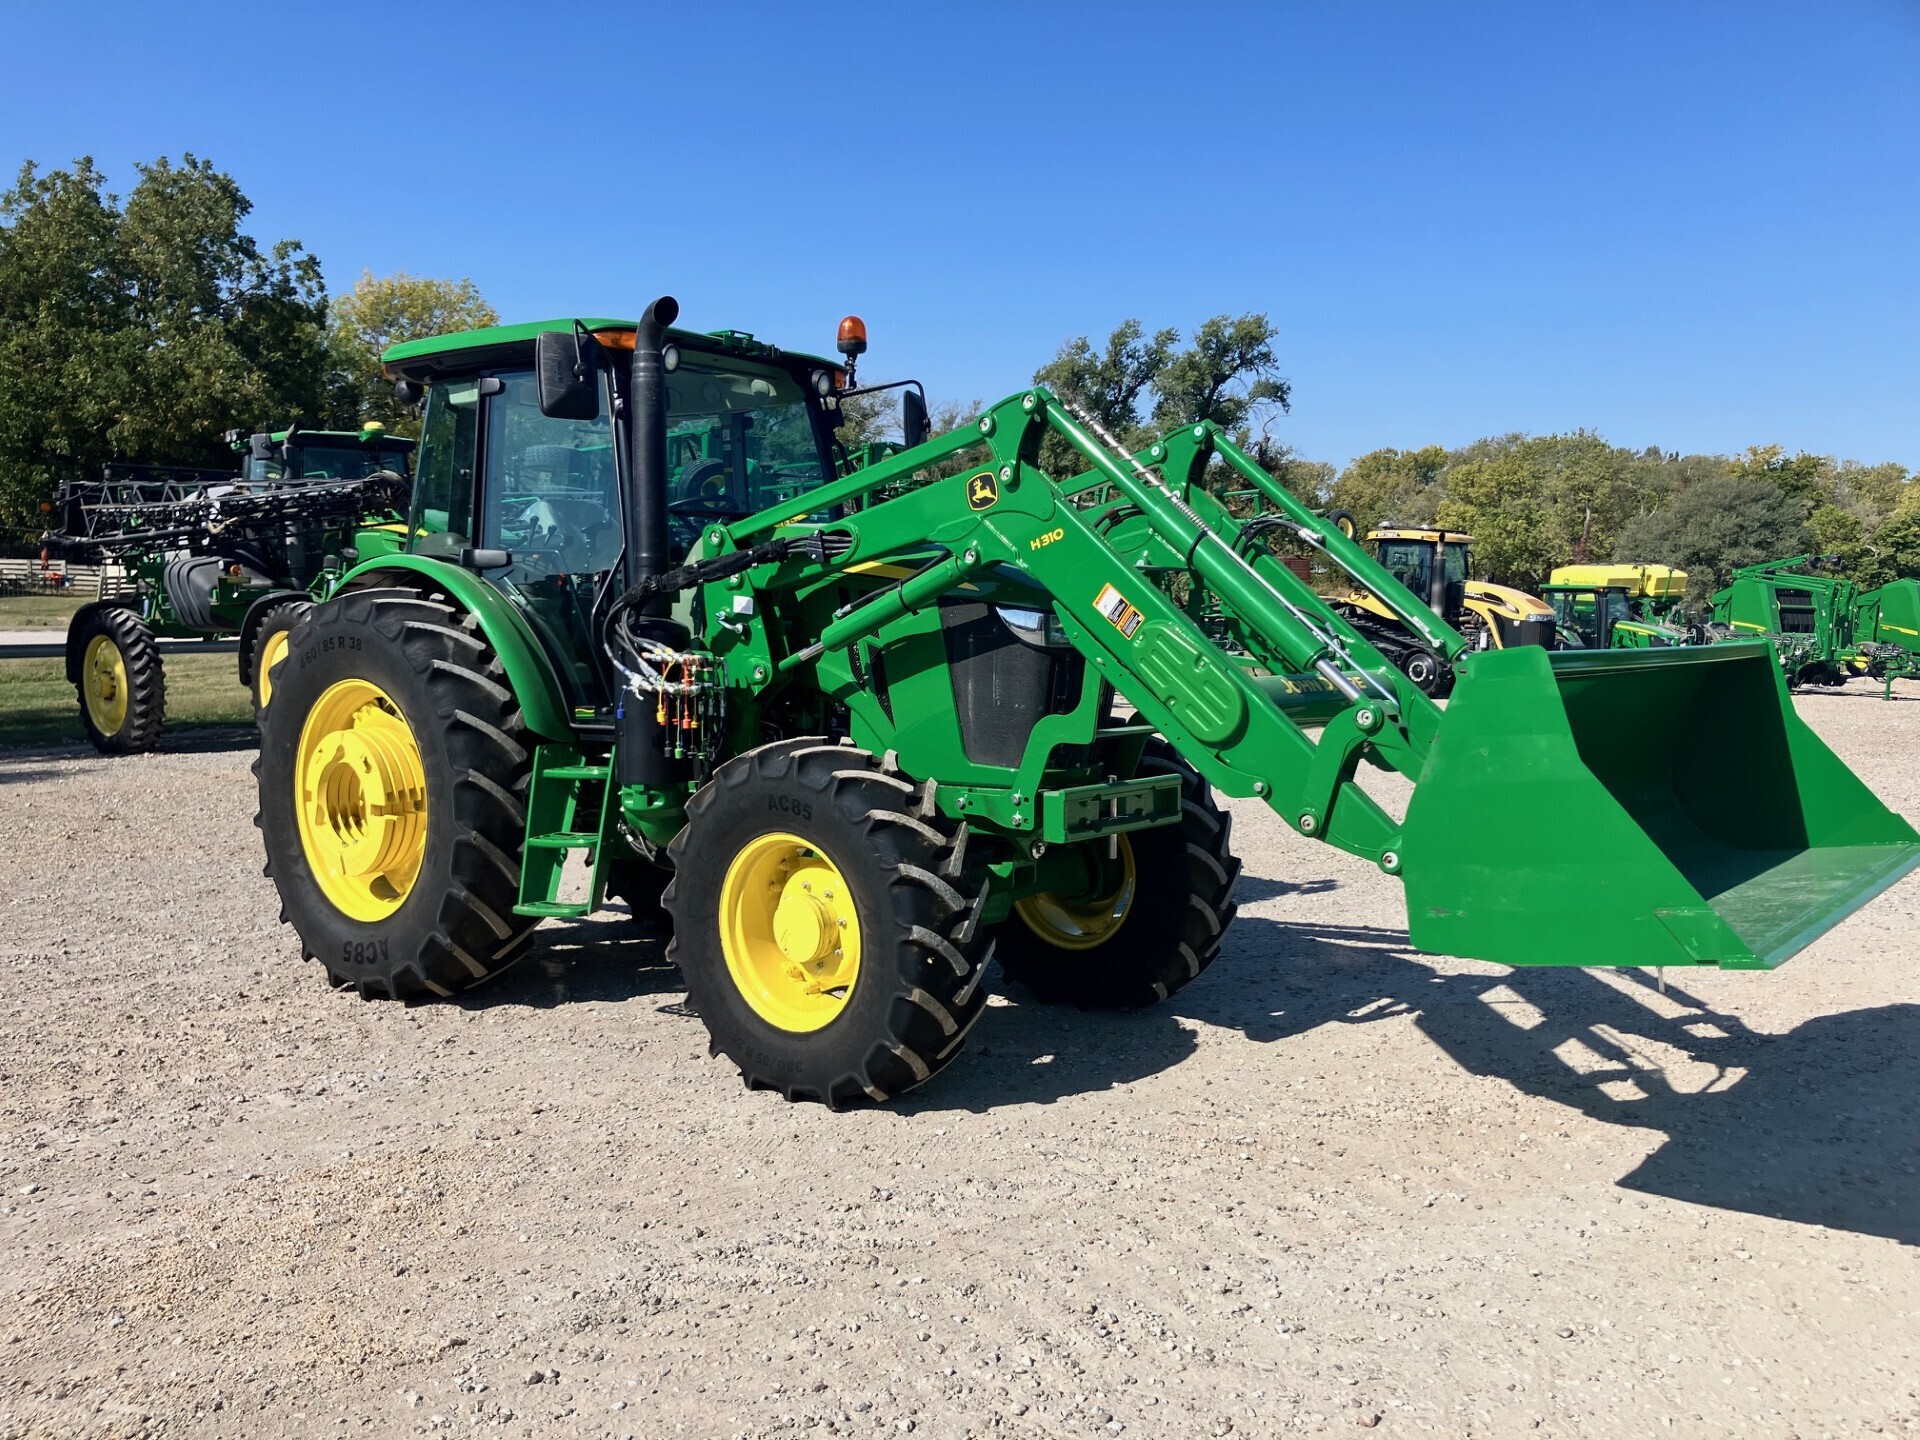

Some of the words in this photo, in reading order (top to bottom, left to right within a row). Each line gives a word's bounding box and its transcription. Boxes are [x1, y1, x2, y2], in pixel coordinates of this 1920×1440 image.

[1030, 528, 1064, 551] H310
[338, 636, 346, 649] R
[349, 636, 362, 651] 38
[1280, 678, 1322, 694] JOHN
[768, 793, 812, 821] AC85
[343, 936, 389, 965] AC85
